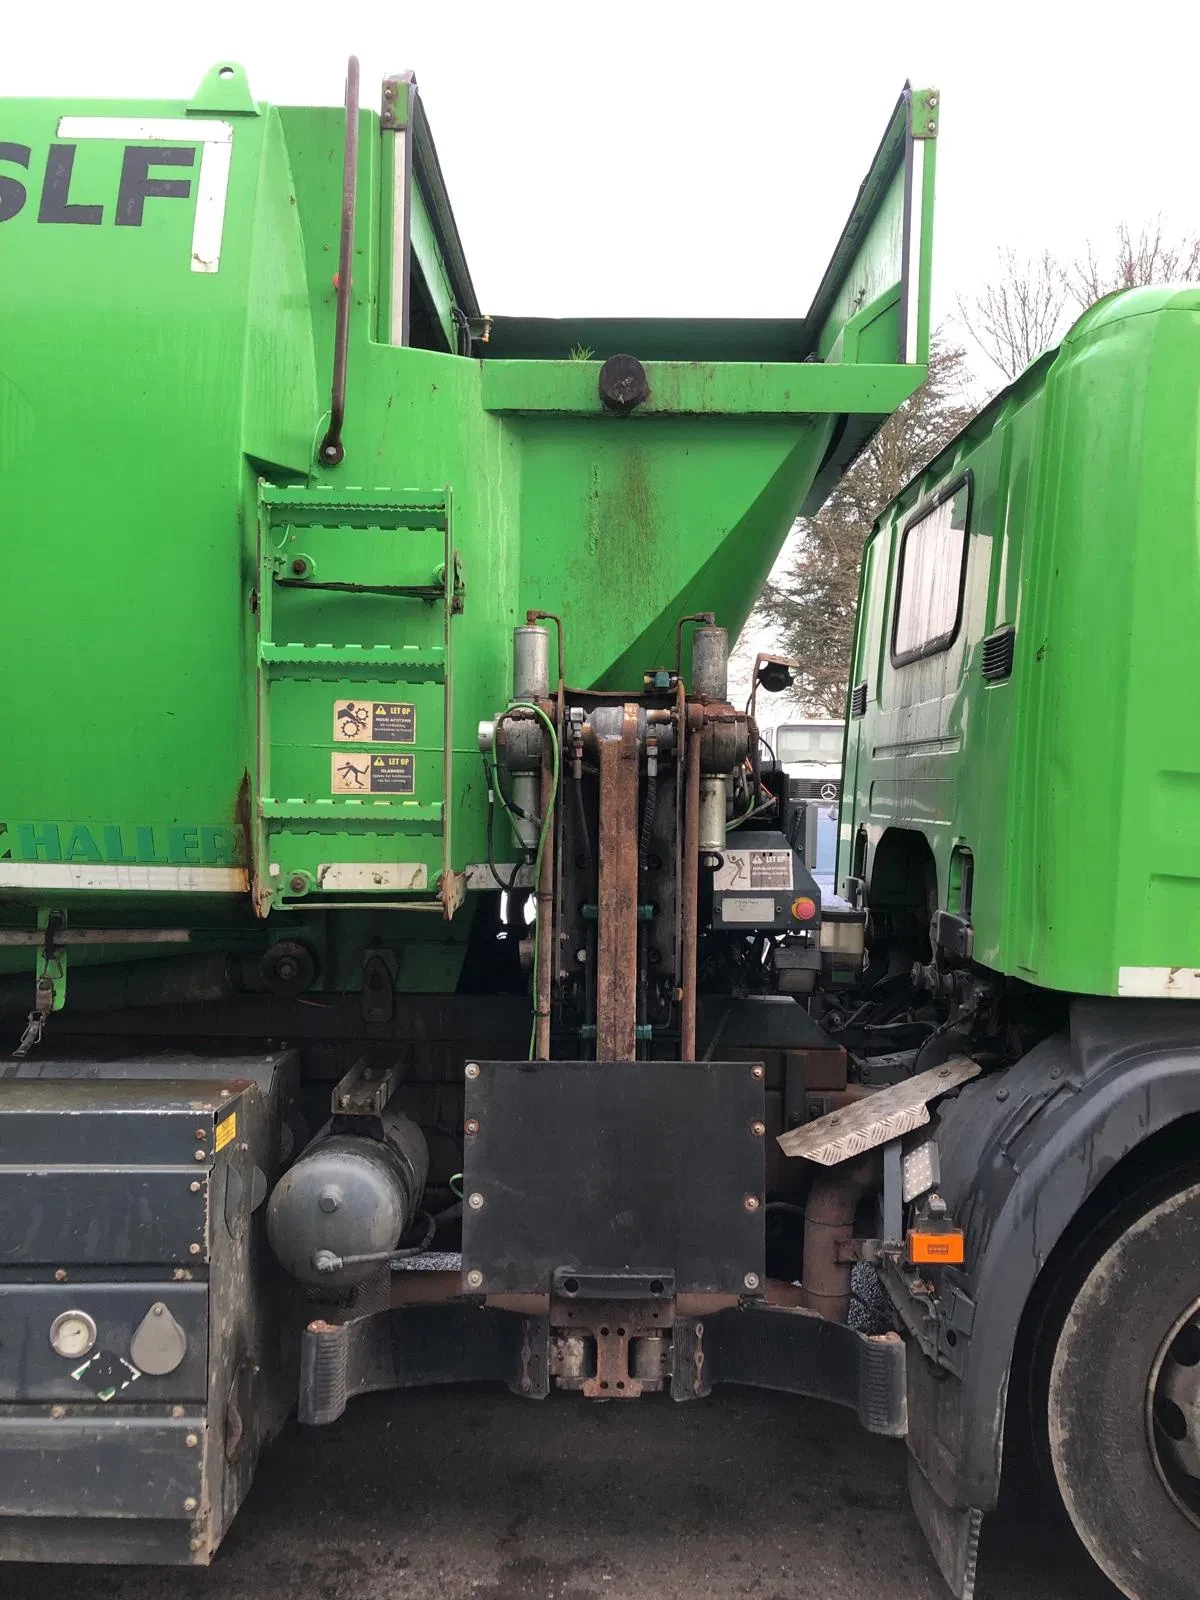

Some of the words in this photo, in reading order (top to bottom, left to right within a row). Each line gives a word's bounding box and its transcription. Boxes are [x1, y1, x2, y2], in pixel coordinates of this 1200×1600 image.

[390, 706, 401, 714] LET
[401, 707, 411, 715] OP
[388, 757, 400, 765] LET
[400, 758, 410, 766] OP
[17, 823, 241, 863] HALLER
[766, 855, 777, 863] LET
